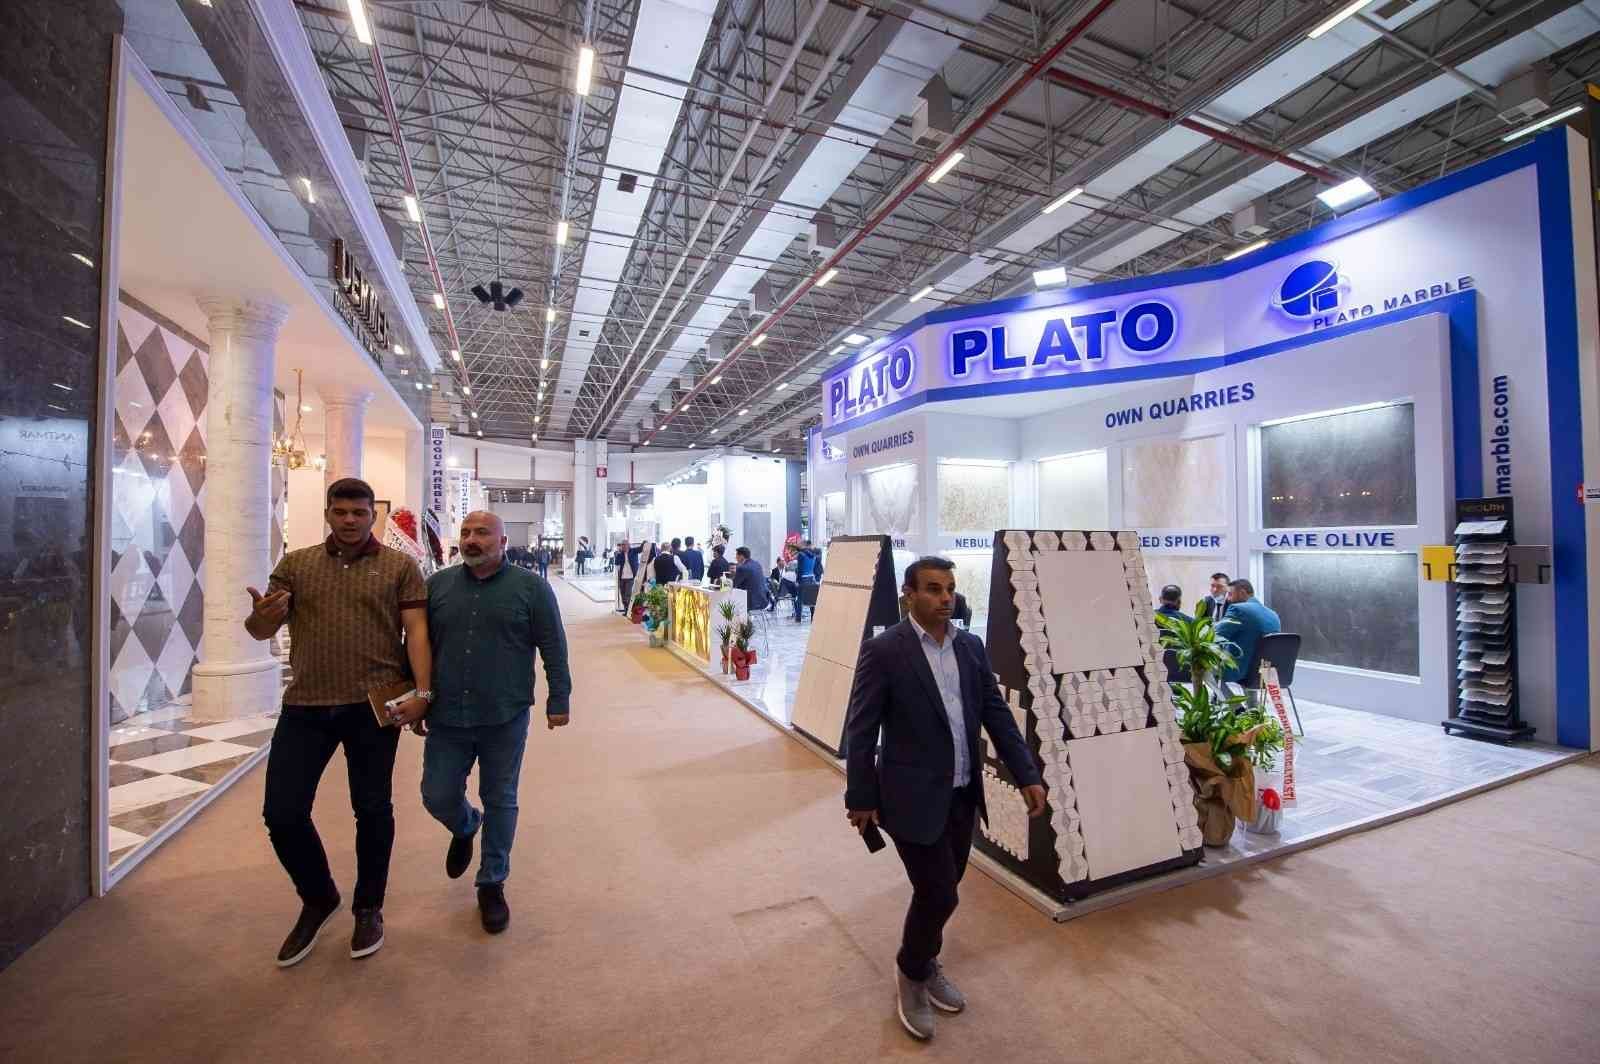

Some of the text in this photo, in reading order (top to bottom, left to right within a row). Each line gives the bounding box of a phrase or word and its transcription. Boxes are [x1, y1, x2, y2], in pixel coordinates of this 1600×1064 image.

[1312, 275, 1474, 330] PLATO MARBLE
[953, 302, 1174, 375] PLATO
[831, 347, 912, 417] PLATO
[1105, 382, 1255, 428] OWN QUARRIES
[853, 430, 914, 458] OWN QUARRIES
[432, 470, 442, 511] MARBLE
[955, 538, 993, 548] NEBUL
[1165, 535, 1220, 547] SPIDER
[1266, 532, 1395, 547] CAFE OLIVE
